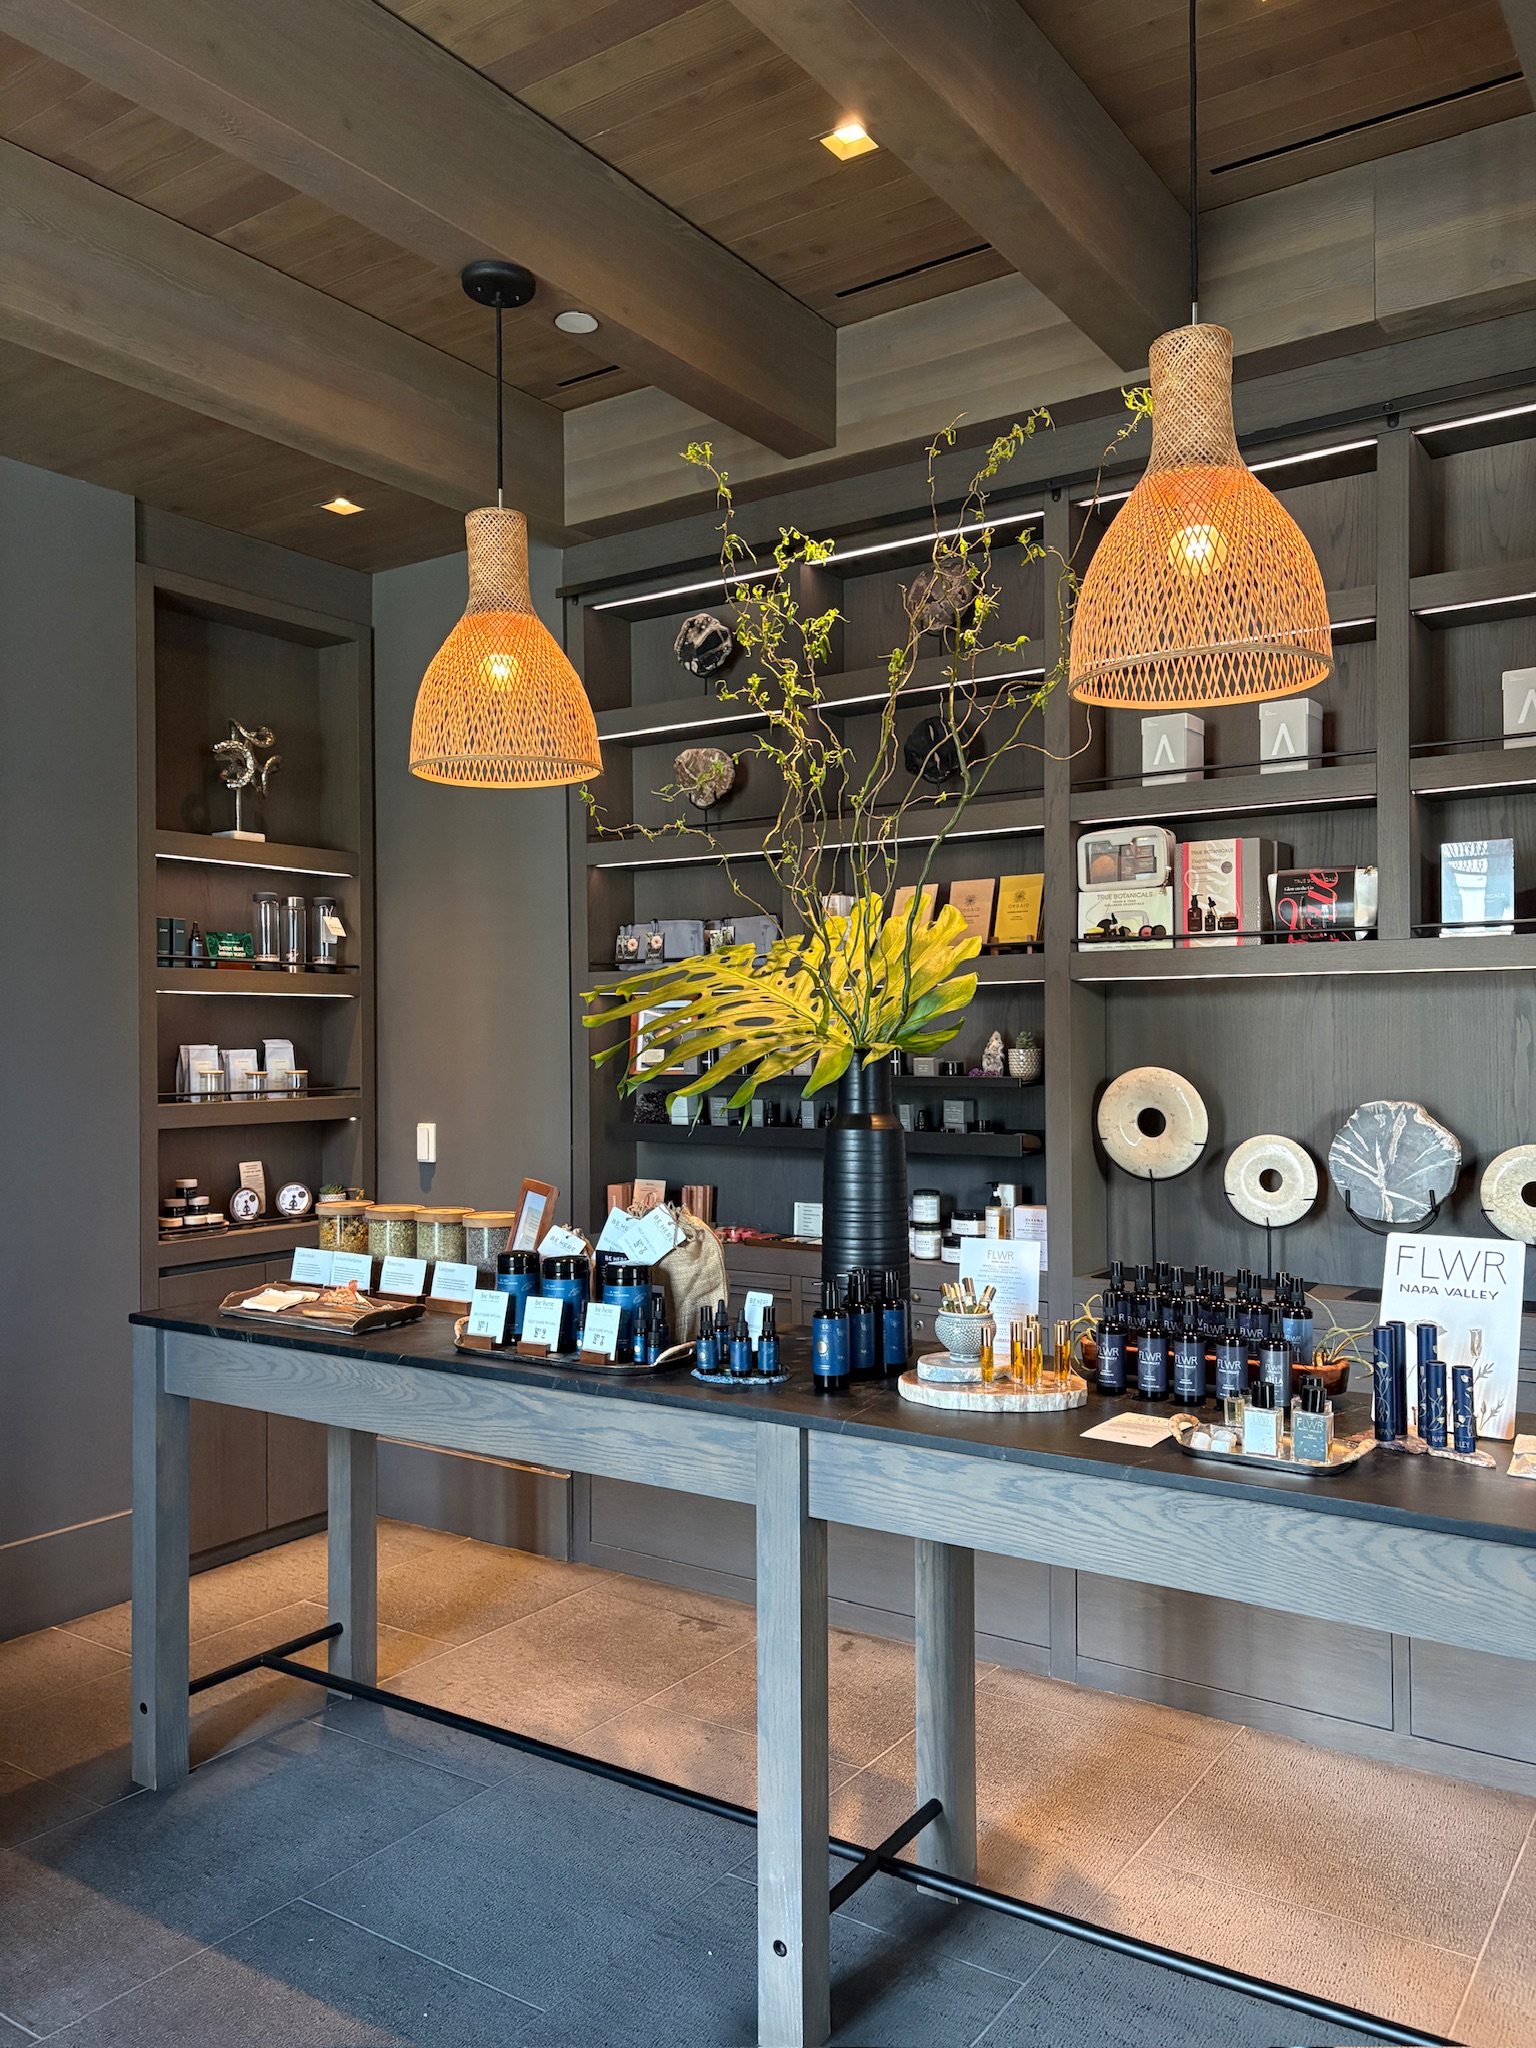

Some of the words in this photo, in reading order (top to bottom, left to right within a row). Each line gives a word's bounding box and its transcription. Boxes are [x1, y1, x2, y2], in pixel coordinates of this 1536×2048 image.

[1113, 891, 1153, 900] BOTANICALS
[559, 1240, 576, 1252] HERE
[987, 1249, 1015, 1260] FLWR
[1396, 1245, 1507, 1285] FLWR
[1399, 1283, 1439, 1296] NAPA
[1444, 1287, 1499, 1300] VALLEY
[602, 1306, 613, 1314] here
[1240, 1327, 1264, 1338] FLWR
[1096, 1345, 1120, 1357] FLWR
[1138, 1350, 1163, 1362] FLWR
[1174, 1354, 1199, 1366] FLWR
[1216, 1358, 1242, 1371] FLWR
[1265, 1363, 1283, 1372] FLWR
[1296, 1416, 1324, 1431] FLWR
